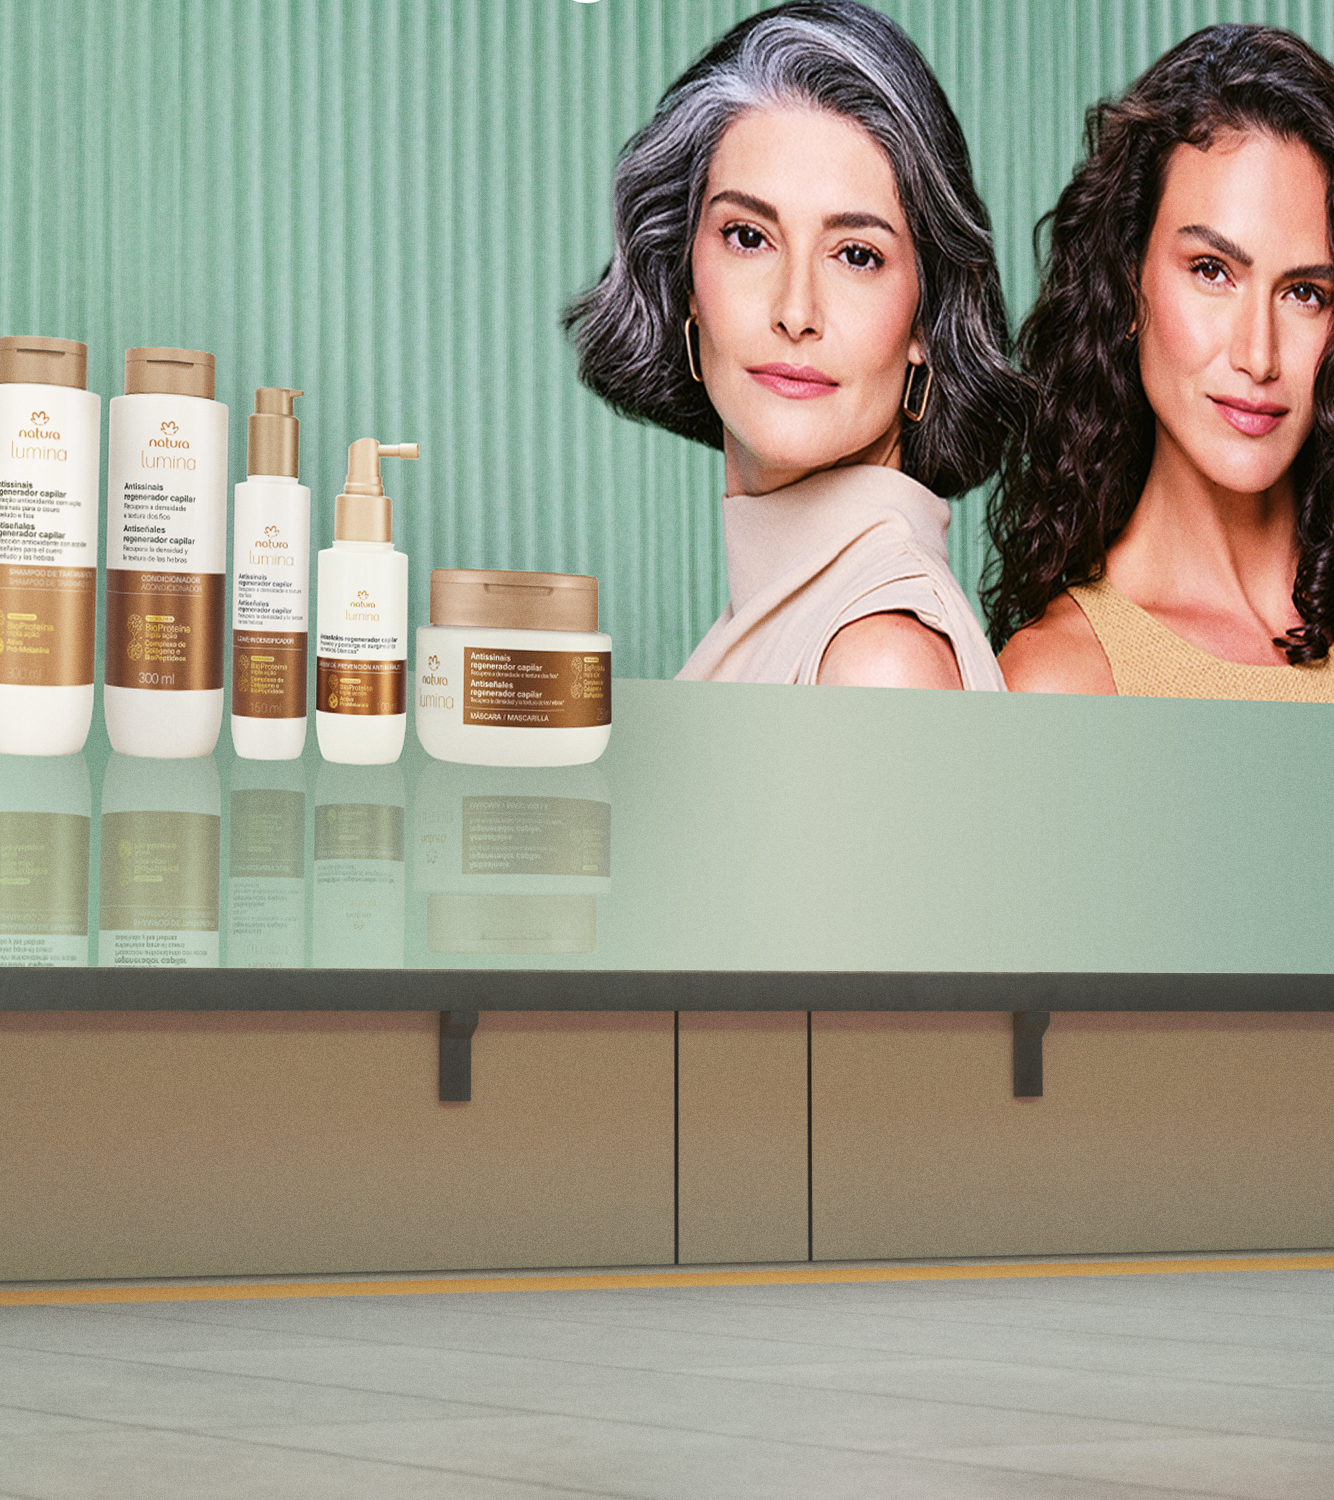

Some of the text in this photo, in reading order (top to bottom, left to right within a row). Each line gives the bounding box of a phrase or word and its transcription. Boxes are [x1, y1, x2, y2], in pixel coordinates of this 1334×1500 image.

[18, 427, 61, 440] natura
[149, 437, 190, 449] natura
[11, 440, 67, 462] lumina
[141, 450, 196, 471] lumina
[124, 482, 164, 491] Antissinais
[39, 490, 67, 499] capilar
[124, 494, 196, 504] regenerador capilar
[123, 524, 166, 534] Antiseñales
[38, 531, 65, 540] capilar
[123, 536, 195, 546] regenerador capilar
[255, 539, 289, 549] natura
[249, 550, 294, 566] lumina
[141, 574, 201, 584] CONDICIONADOR
[346, 609, 380, 622] lumina
[470, 652, 511, 662] Antissinais
[470, 662, 543, 672] regenerador capilar
[138, 671, 175, 685] 300 ml
[422, 673, 448, 686] natura
[470, 679, 514, 689] Antiseñales
[419, 687, 454, 710] lumina
[470, 689, 543, 700] regenerador capilar
[470, 711, 502, 721] MÁSCARA
[506, 714, 549, 722] MASCARILLA
